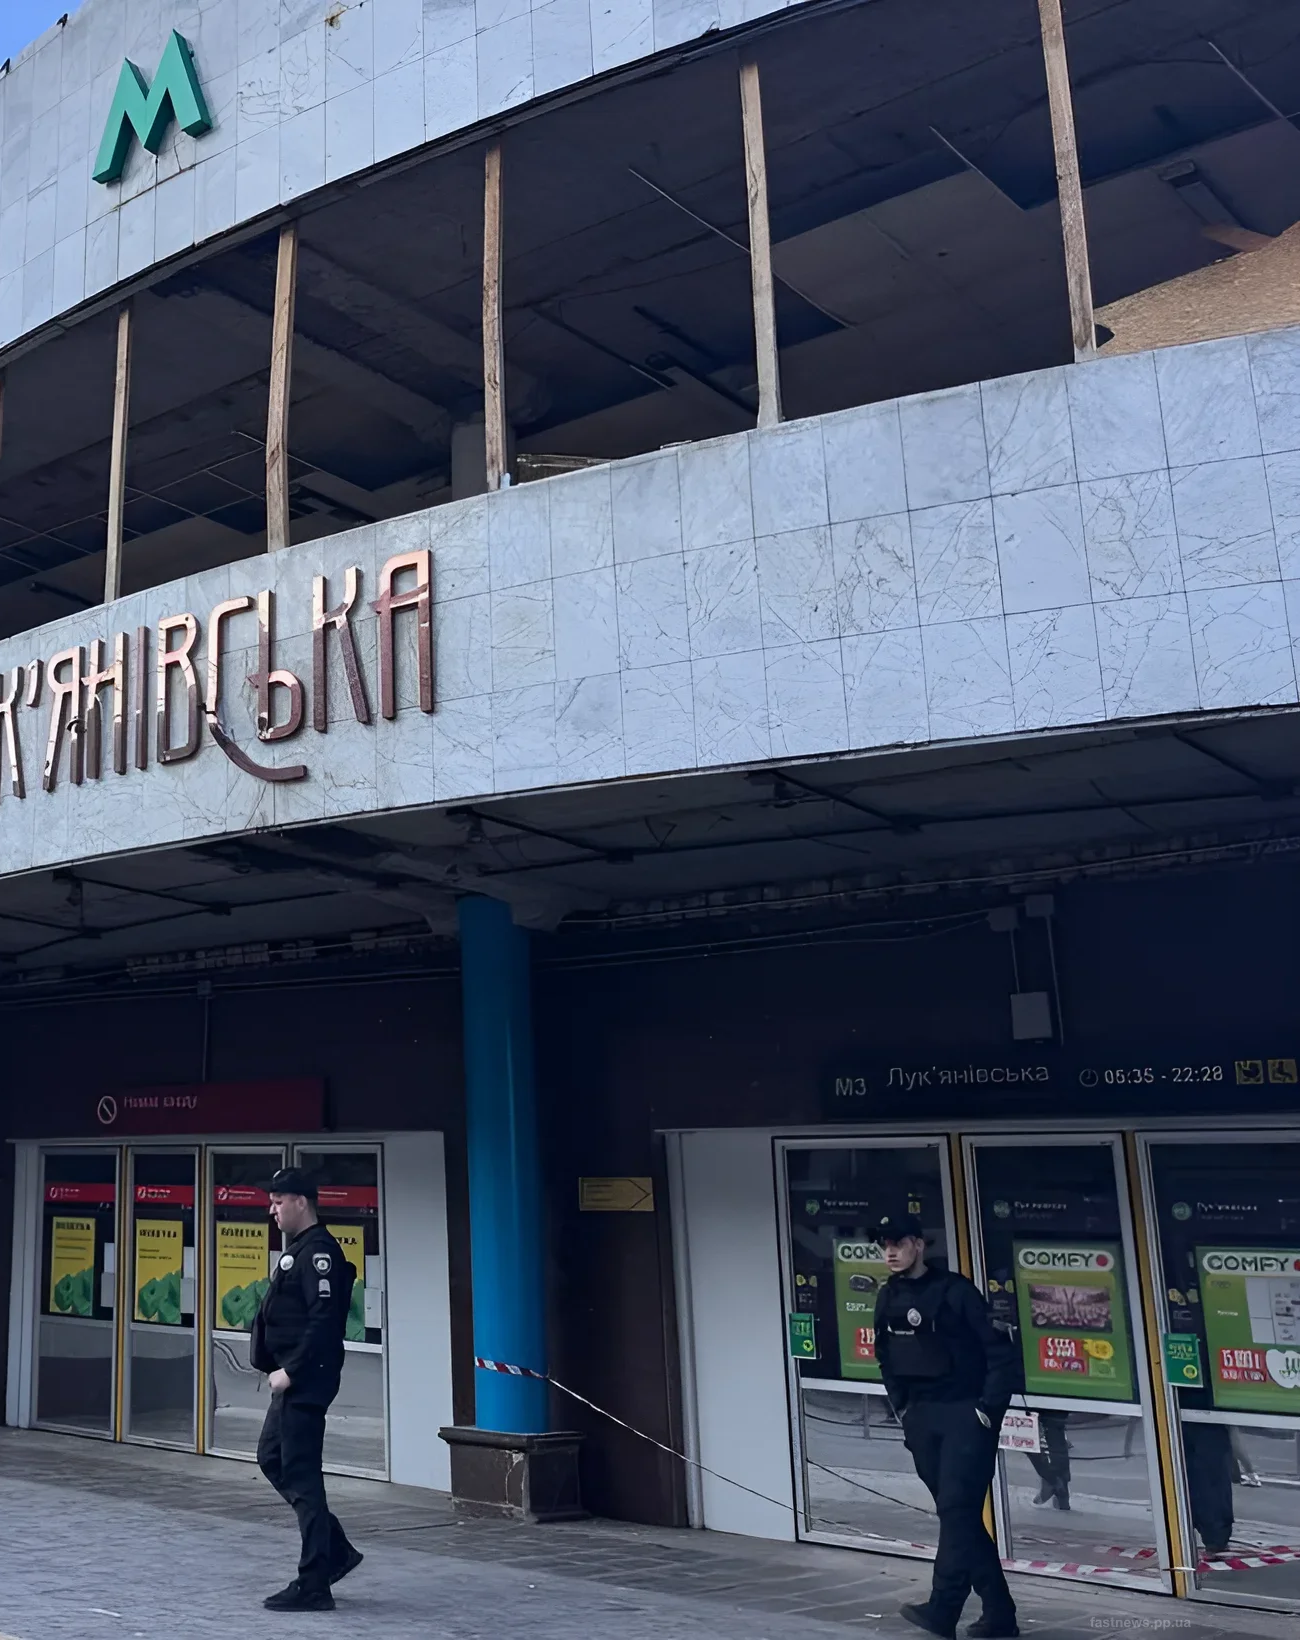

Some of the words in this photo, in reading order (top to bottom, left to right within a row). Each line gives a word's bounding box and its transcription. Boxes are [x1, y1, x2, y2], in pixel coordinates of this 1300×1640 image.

[92, 28, 213, 184] М
[835, 1077, 867, 1096] М3
[886, 1064, 1050, 1091] Лук'янівська
[1171, 1065, 1223, 1082] 22:28
[840, 1245, 886, 1260] COM
[1023, 1251, 1094, 1268] COMFY
[1207, 1255, 1289, 1272] COMFY
